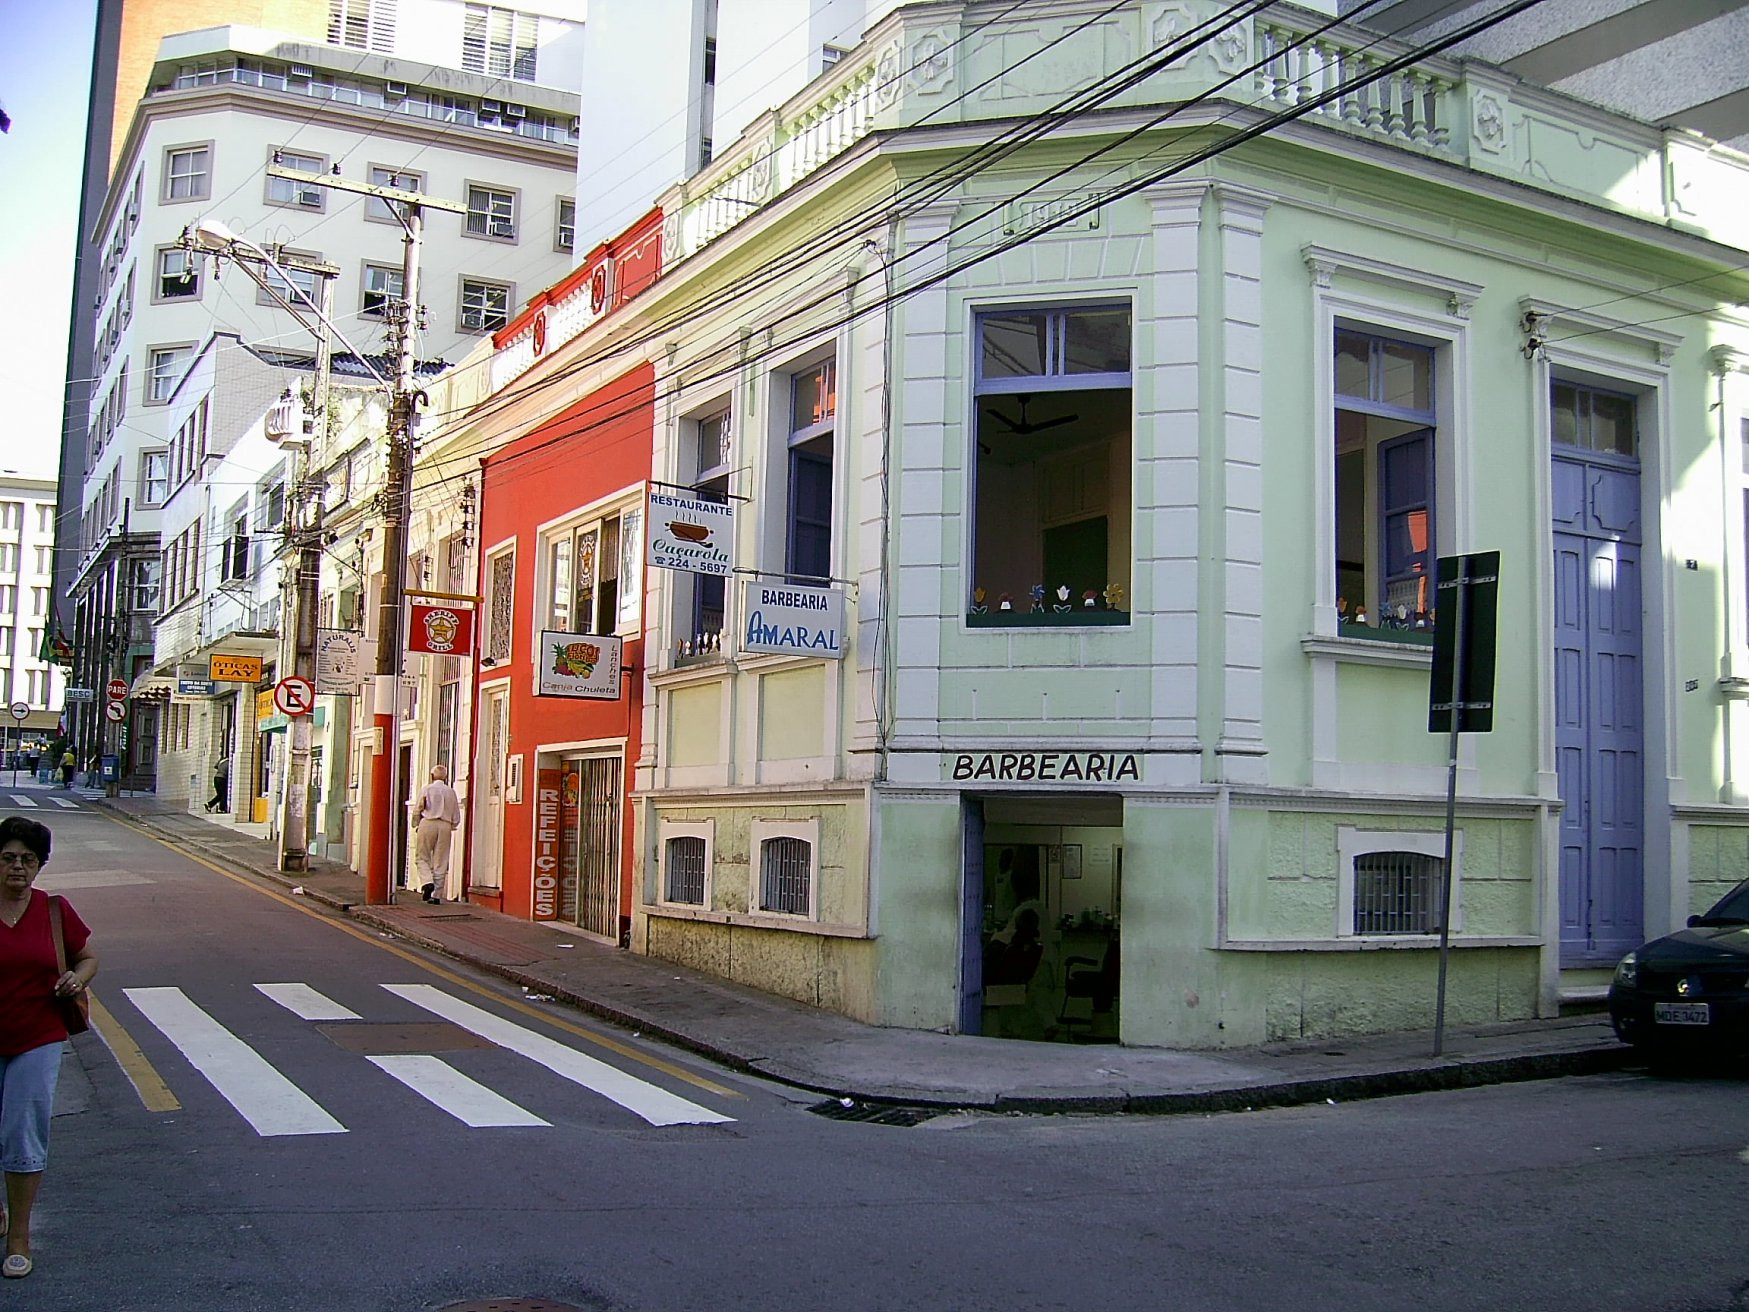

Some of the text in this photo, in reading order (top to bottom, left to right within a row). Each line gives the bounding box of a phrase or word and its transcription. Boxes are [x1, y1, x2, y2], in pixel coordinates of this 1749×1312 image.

[650, 494, 733, 516] RESTAURANTE
[652, 538, 730, 563] Caçarola
[668, 557, 690, 570] 224
[699, 562, 728, 574] 5697
[761, 589, 828, 611] BARBEARIA
[747, 610, 839, 651] AMARAL
[321, 634, 357, 654] NATURALIS
[218, 668, 255, 677] LAY
[67, 690, 90, 698] BESC
[108, 685, 127, 695] PARE
[575, 685, 616, 694] Chuleta
[952, 754, 1139, 782] BARBEARIA
[535, 788, 559, 916] REFEIÇÕES
